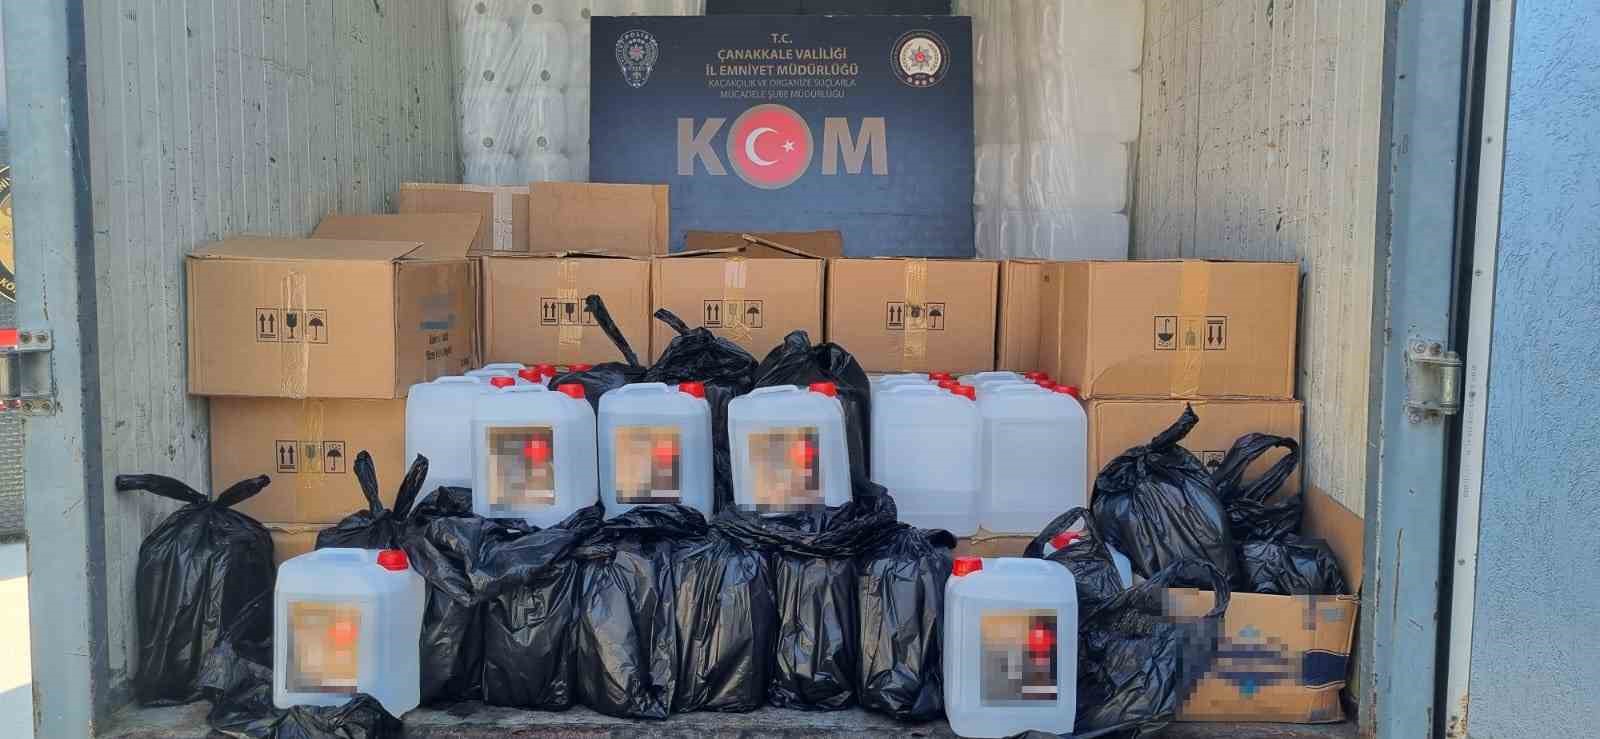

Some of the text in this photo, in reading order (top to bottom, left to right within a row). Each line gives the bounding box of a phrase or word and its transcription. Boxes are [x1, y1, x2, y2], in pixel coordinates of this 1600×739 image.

[771, 33, 793, 44] T.C.
[717, 47, 847, 63] ÇANAKKALE VALİLİĞİ
[706, 63, 859, 76] İL EMNİYET MÜDÜRLÜĞÜ
